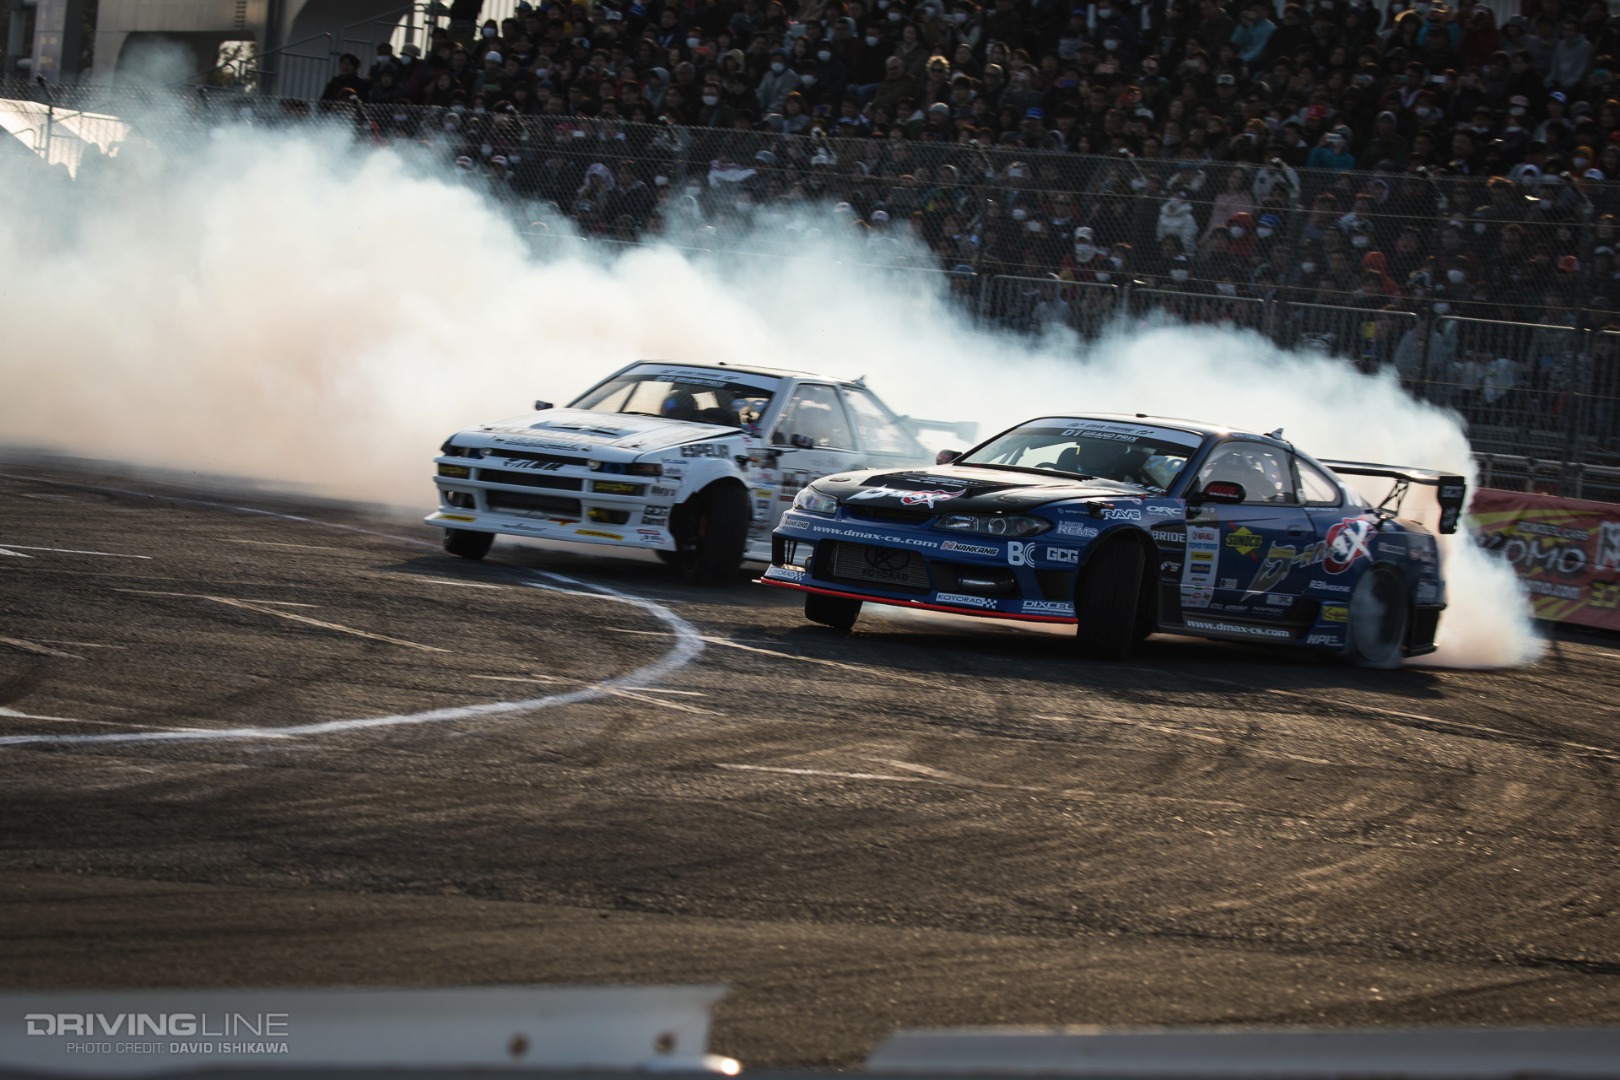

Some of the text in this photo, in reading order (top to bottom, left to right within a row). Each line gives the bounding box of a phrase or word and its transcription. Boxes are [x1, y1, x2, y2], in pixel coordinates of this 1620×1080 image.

[1083, 431, 1115, 440] GRAND
[1115, 435, 1139, 443] PRIX
[1102, 509, 1141, 520] RAYS
[813, 525, 938, 548] www.dmax-cs.com
[1057, 524, 1098, 537] REMS
[1152, 530, 1186, 543] BRIDE
[1226, 534, 1262, 548] SUNOCO
[954, 543, 999, 556] NANKANG
[1046, 547, 1079, 563] GCG
[938, 593, 983, 604] KOYORAD
[1022, 600, 1074, 612] DIXCEL
[1187, 619, 1290, 638] www.dmax-cs.com
